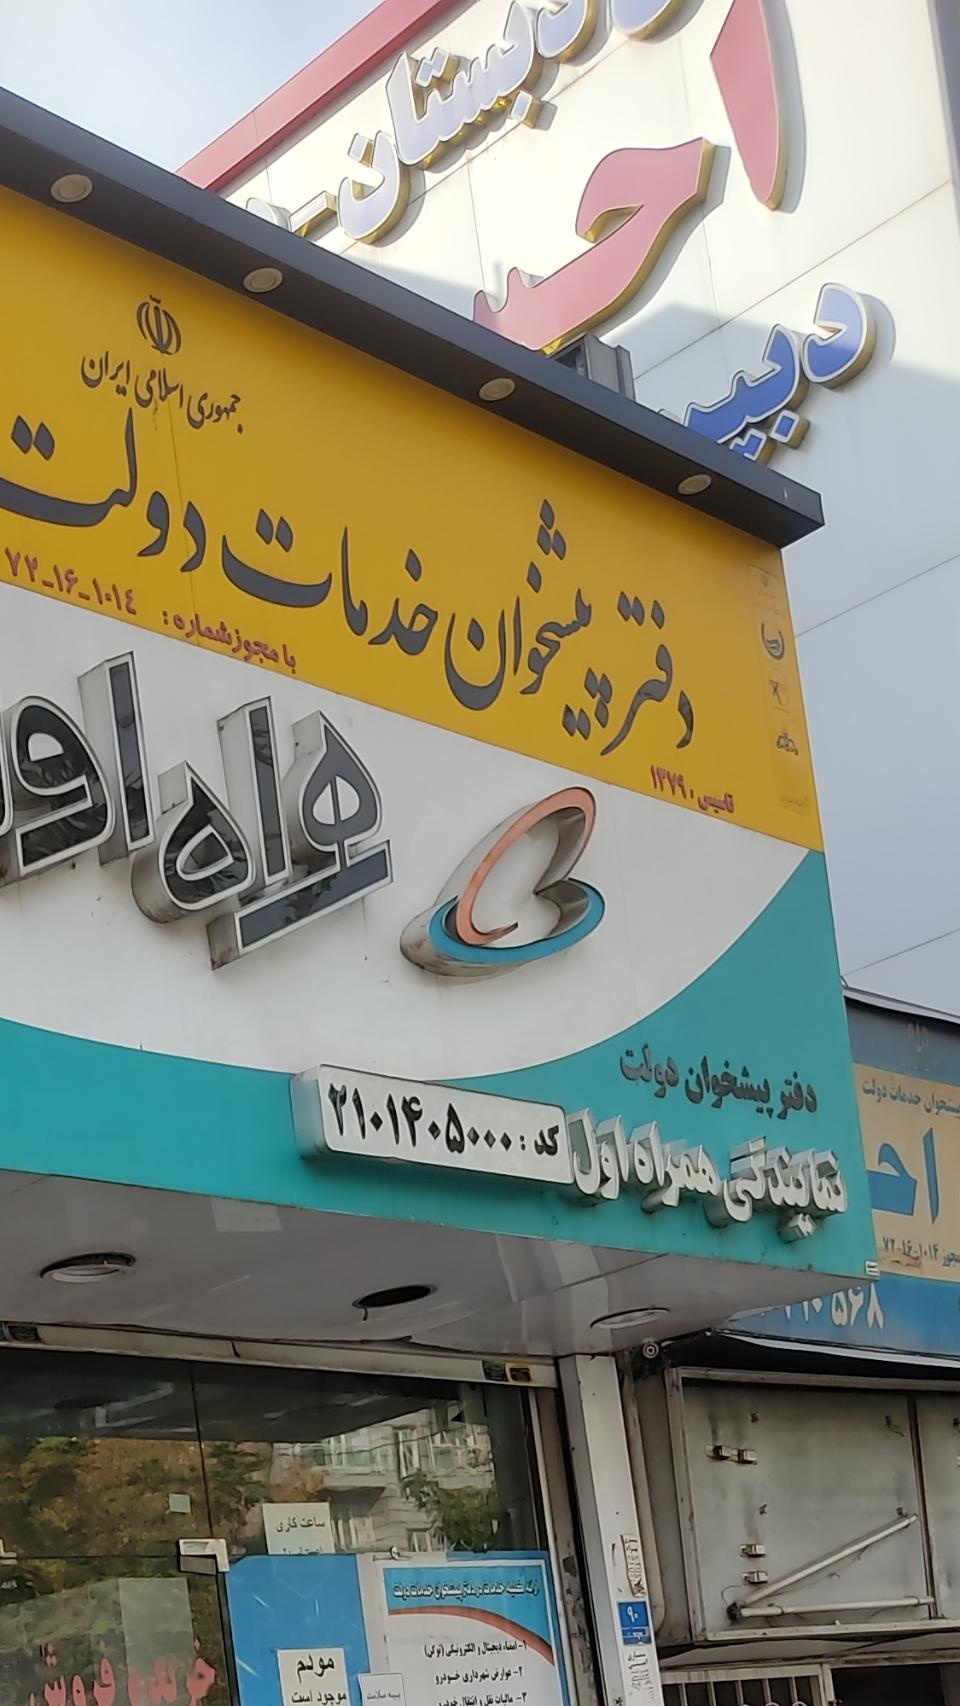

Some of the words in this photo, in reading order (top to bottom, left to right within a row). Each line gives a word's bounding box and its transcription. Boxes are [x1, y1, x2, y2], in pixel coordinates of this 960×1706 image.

[81, 350, 131, 397] ایران
[135, 368, 184, 408] اسلامی
[187, 392, 243, 434] جمهوری
[220, 508, 440, 657] خدمات
[444, 498, 614, 741] پیشخوان
[231, 629, 280, 664] مجوز
[282, 644, 297, 674] با
[600, 590, 695, 757] دفتر
[143, 697, 395, 964] همراه
[619, 1043, 680, 1098] دولت
[684, 1055, 774, 1119] پیشخوان
[777, 1071, 819, 1120] دفتر
[862, 1077, 887, 1103] دولت
[328, 1083, 513, 1155] ۲۱۰۱۴۰۵۰۰۰
[570, 1107, 630, 1200] اول
[634, 1119, 721, 1208] همراه
[723, 1136, 848, 1239] نمایندگی
[291, 1689, 313, 1703] است
[317, 1690, 347, 1706] موجود
[435, 1670, 460, 1685] خودرو
